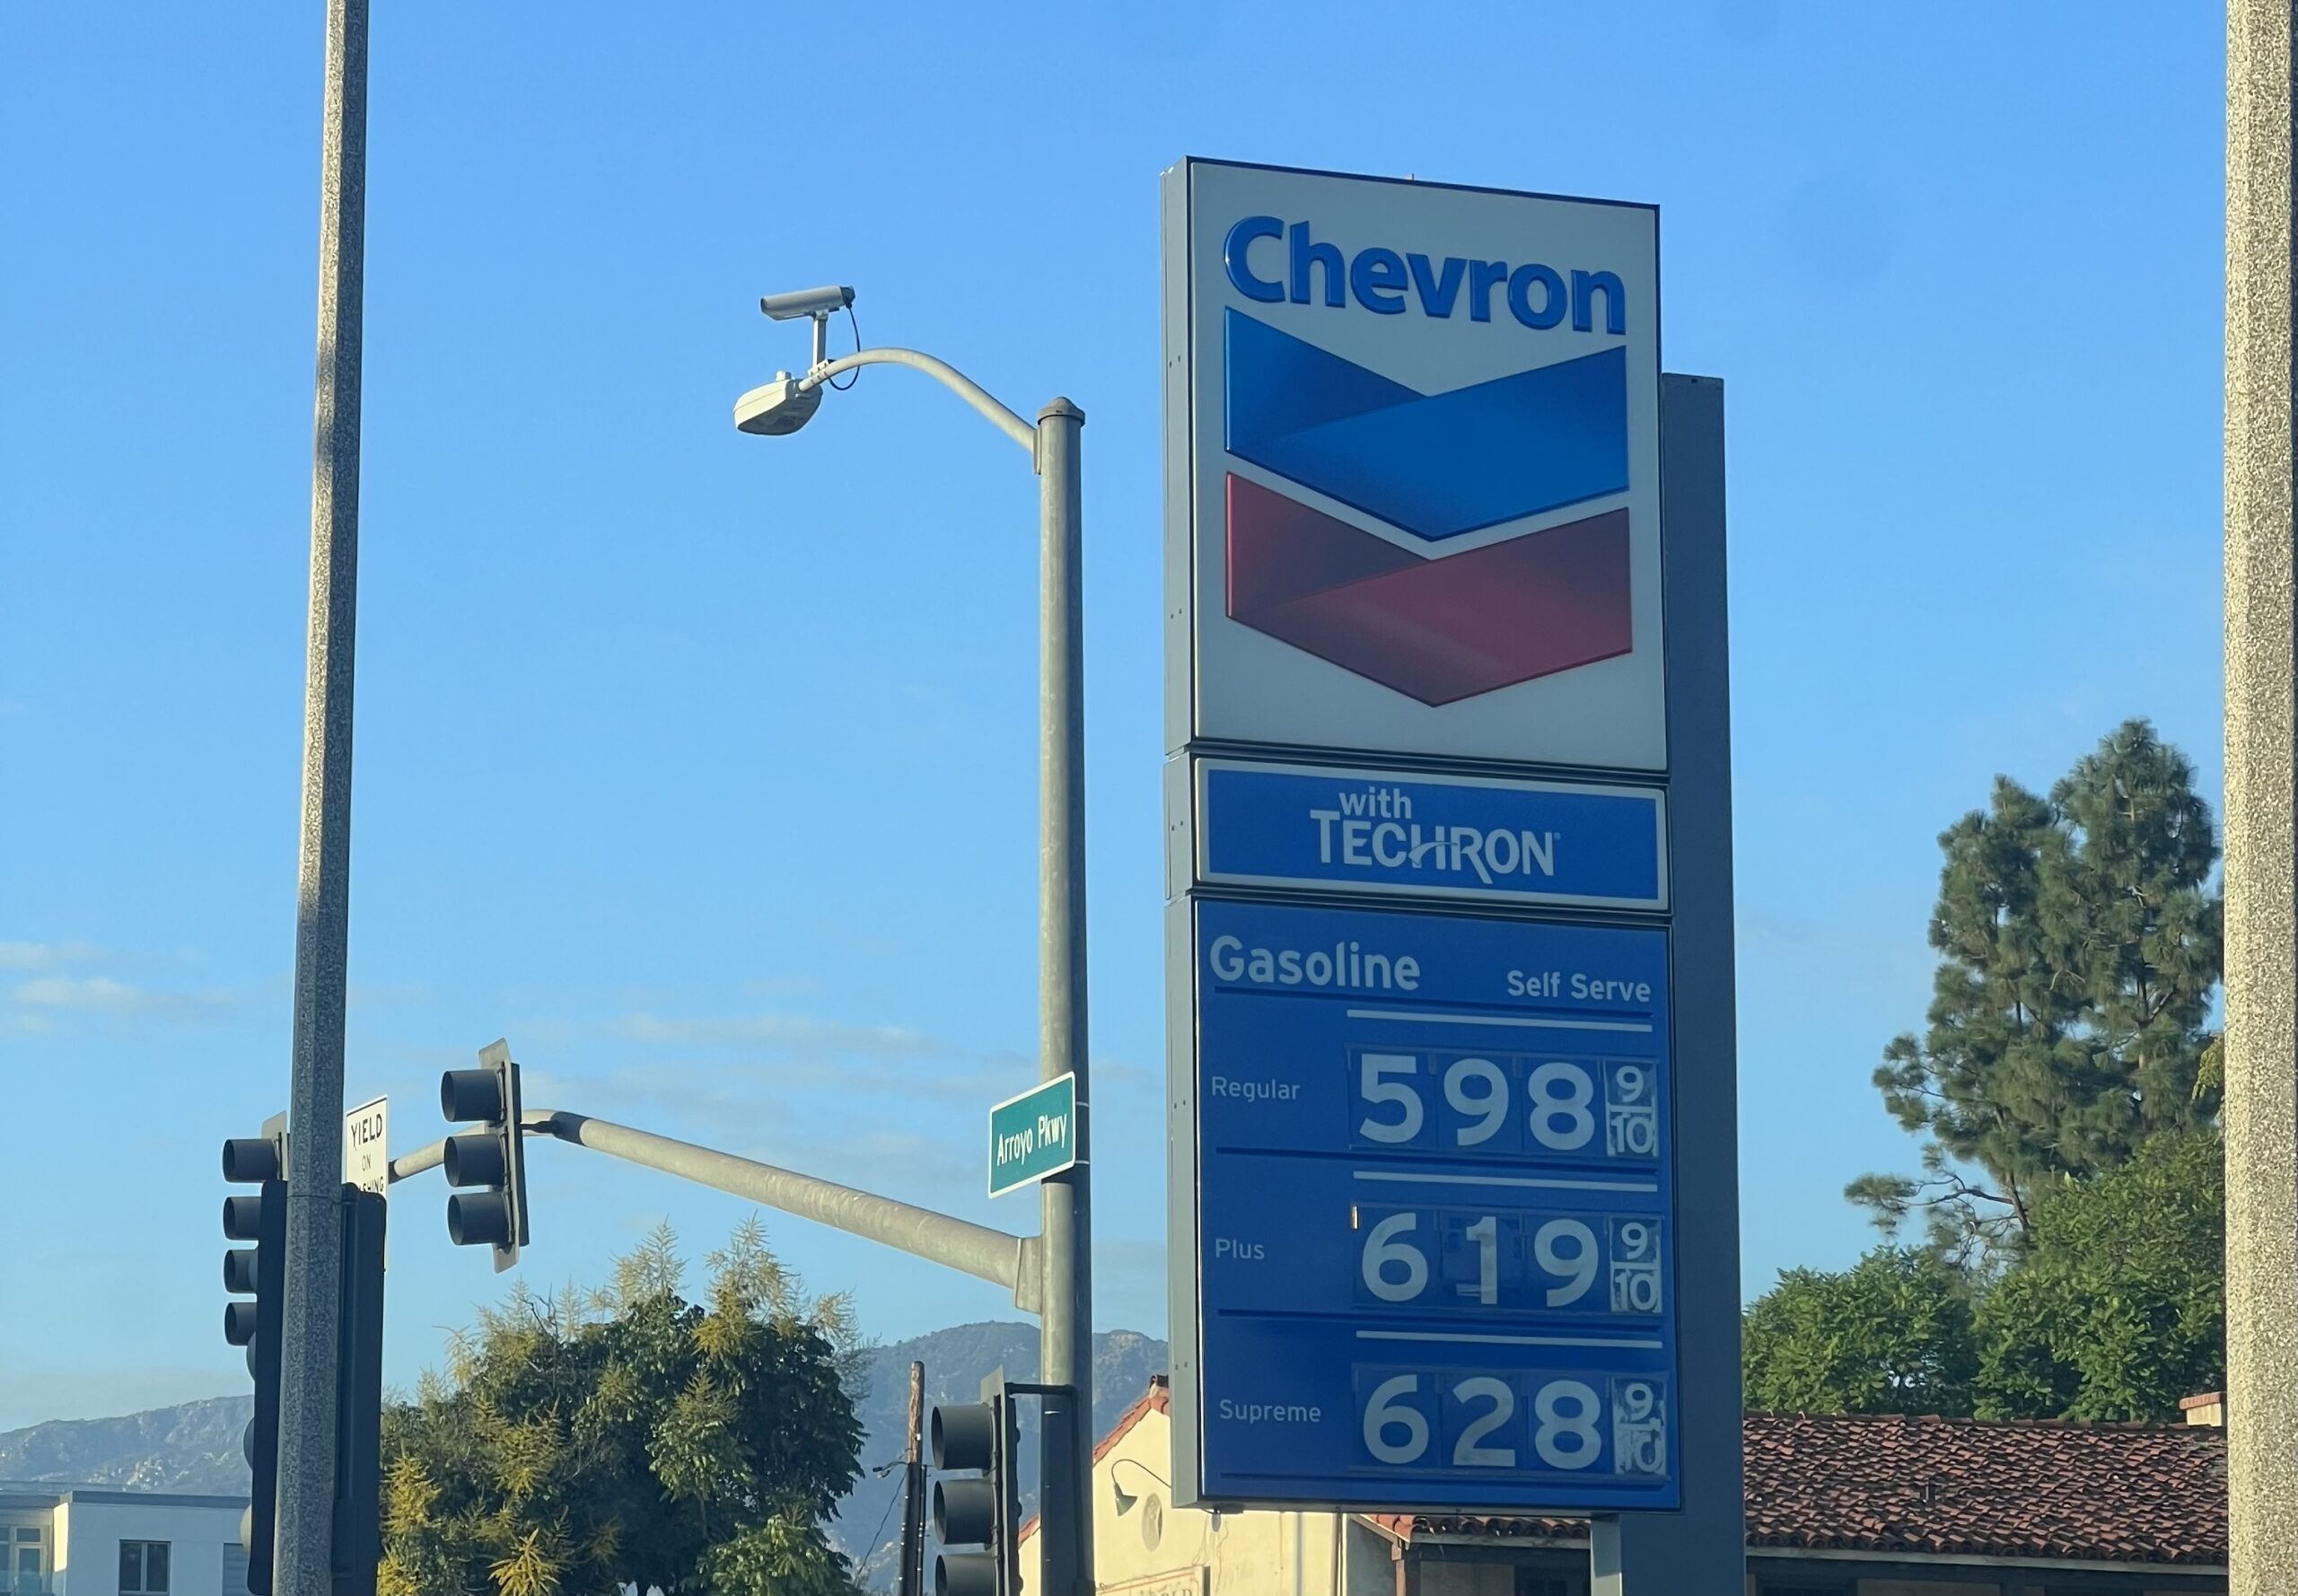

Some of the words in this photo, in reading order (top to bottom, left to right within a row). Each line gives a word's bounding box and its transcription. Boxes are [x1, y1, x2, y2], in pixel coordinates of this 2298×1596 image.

[1224, 215, 1627, 336] Chevron
[1338, 785, 1412, 820] with
[1309, 809, 1555, 884] TECHRON
[1209, 934, 1421, 990] Gasoline
[1506, 969, 1561, 998] Self
[1570, 973, 1652, 1003] Serve
[1210, 1076, 1301, 1102] Regular
[1358, 1052, 1596, 1151] 598
[350, 1113, 383, 1148] YIELD
[996, 1127, 1033, 1167] Arroyo
[1038, 1113, 1067, 1149] Pkwy
[361, 1153, 372, 1172] ON
[1215, 1237, 1266, 1260] Plus
[1361, 1212, 1600, 1308] 619
[1219, 1399, 1322, 1425] Supreme
[1363, 1373, 1601, 1470] 628
